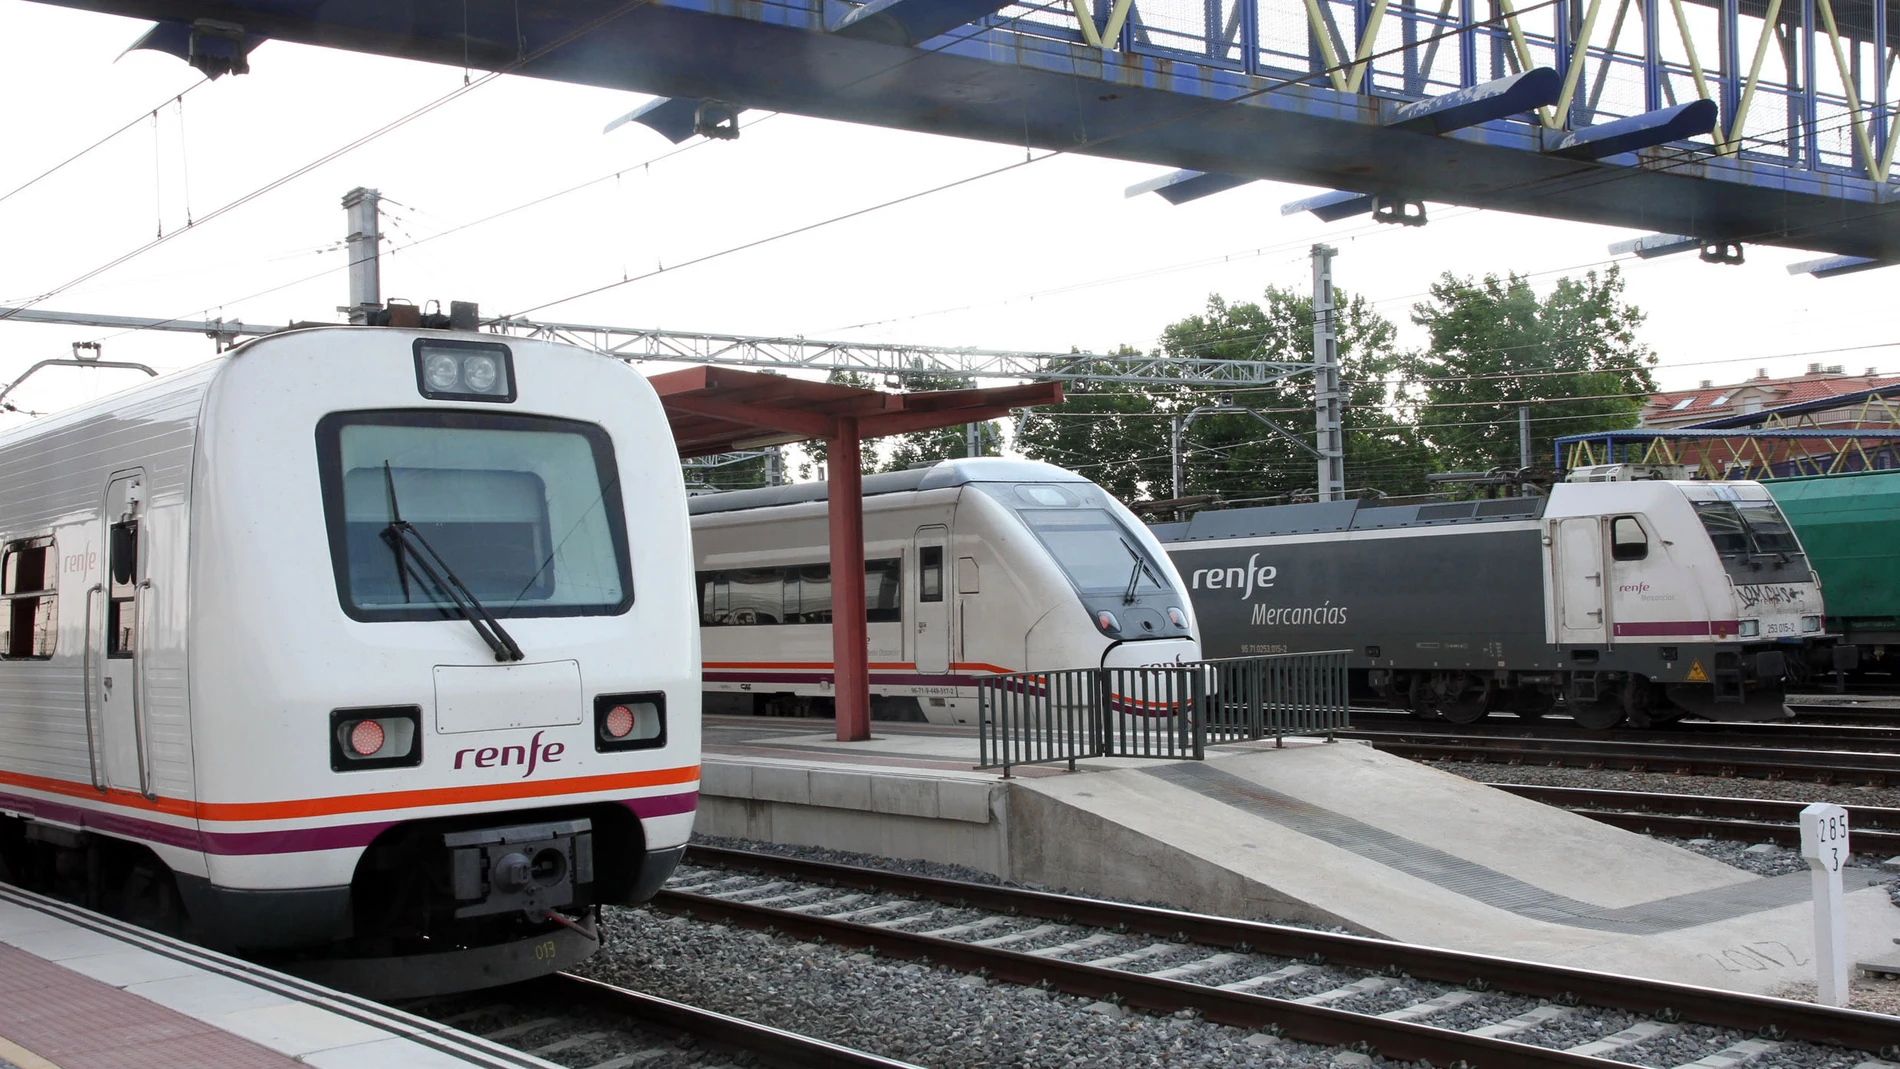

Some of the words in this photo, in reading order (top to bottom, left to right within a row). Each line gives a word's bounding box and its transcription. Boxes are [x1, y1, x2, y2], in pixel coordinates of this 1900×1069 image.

[64, 540, 97, 584] renfe
[1192, 552, 1277, 600] renfe
[1619, 581, 1650, 594] renfe
[1251, 600, 1347, 625] Mercancías
[1767, 623, 1778, 634] 253
[1779, 622, 1795, 633] 015-2
[453, 730, 565, 778] renfe
[1819, 815, 1846, 842] 285
[1831, 848, 1839, 871] 3
[535, 941, 555, 960] 013
[1697, 941, 1810, 972] 2012
